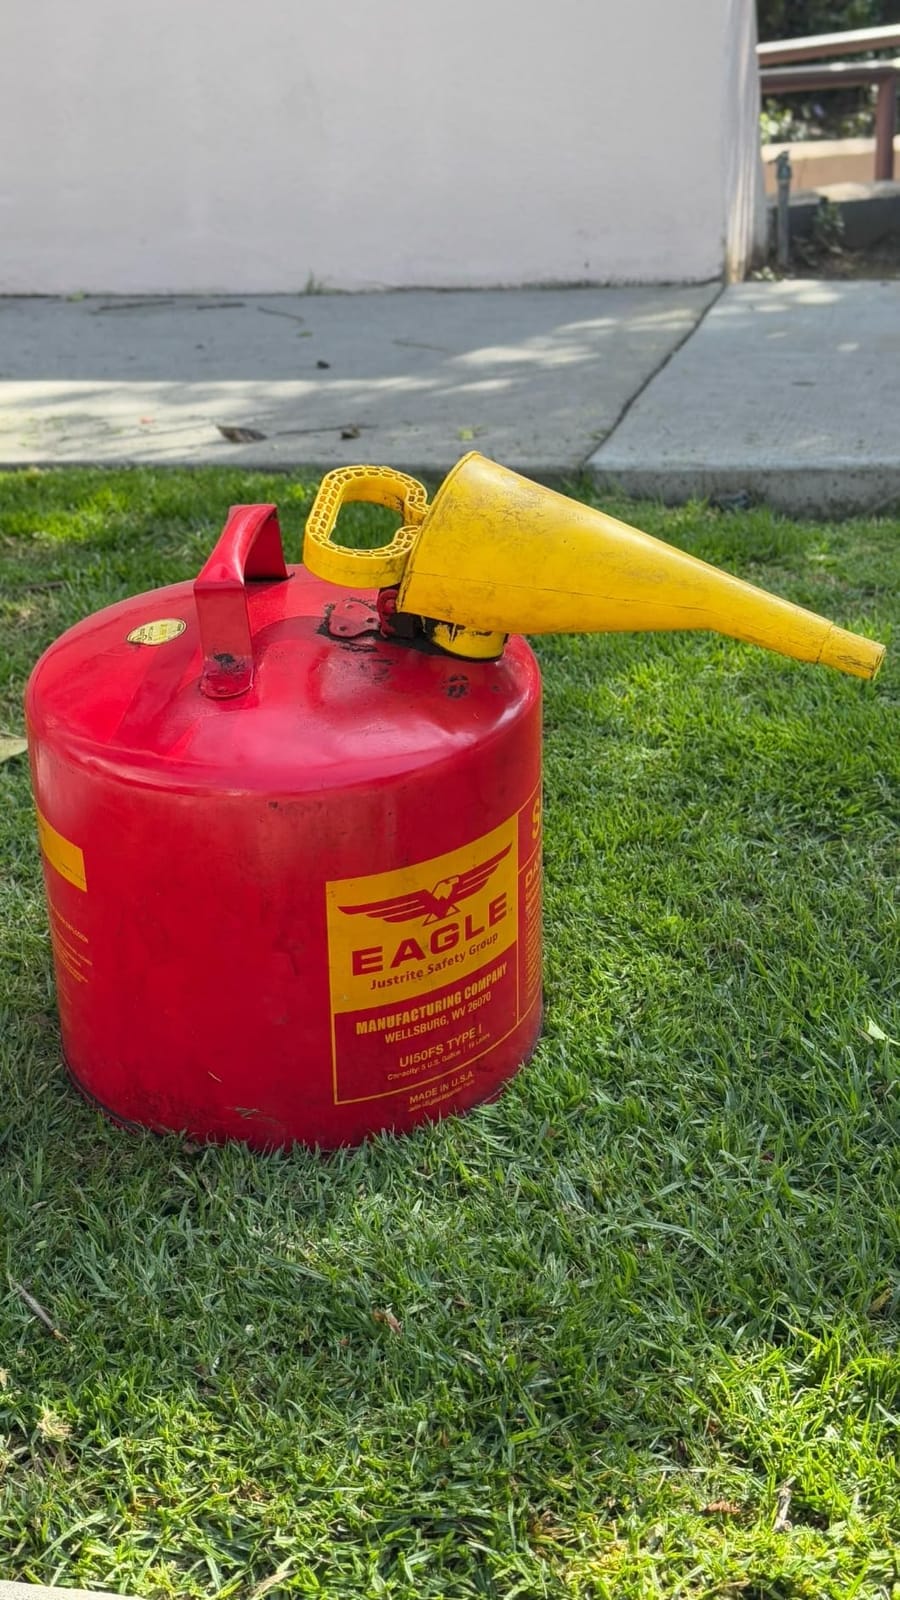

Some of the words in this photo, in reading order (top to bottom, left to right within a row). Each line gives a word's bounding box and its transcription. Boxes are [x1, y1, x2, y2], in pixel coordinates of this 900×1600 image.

[352, 892, 508, 976] EAGLE
[370, 969, 424, 991] Justrite
[427, 952, 466, 977] Safety
[469, 932, 499, 958] Group
[356, 990, 462, 1035] MANUFACTURING
[464, 962, 508, 1004] COMPANY
[385, 1015, 450, 1044] WELLSBURG,
[451, 1006, 466, 1021] WV
[468, 991, 492, 1013] 26070
[447, 1027, 476, 1050] TYPE
[409, 1086, 438, 1104] MADE
[440, 1082, 449, 1092] IN
